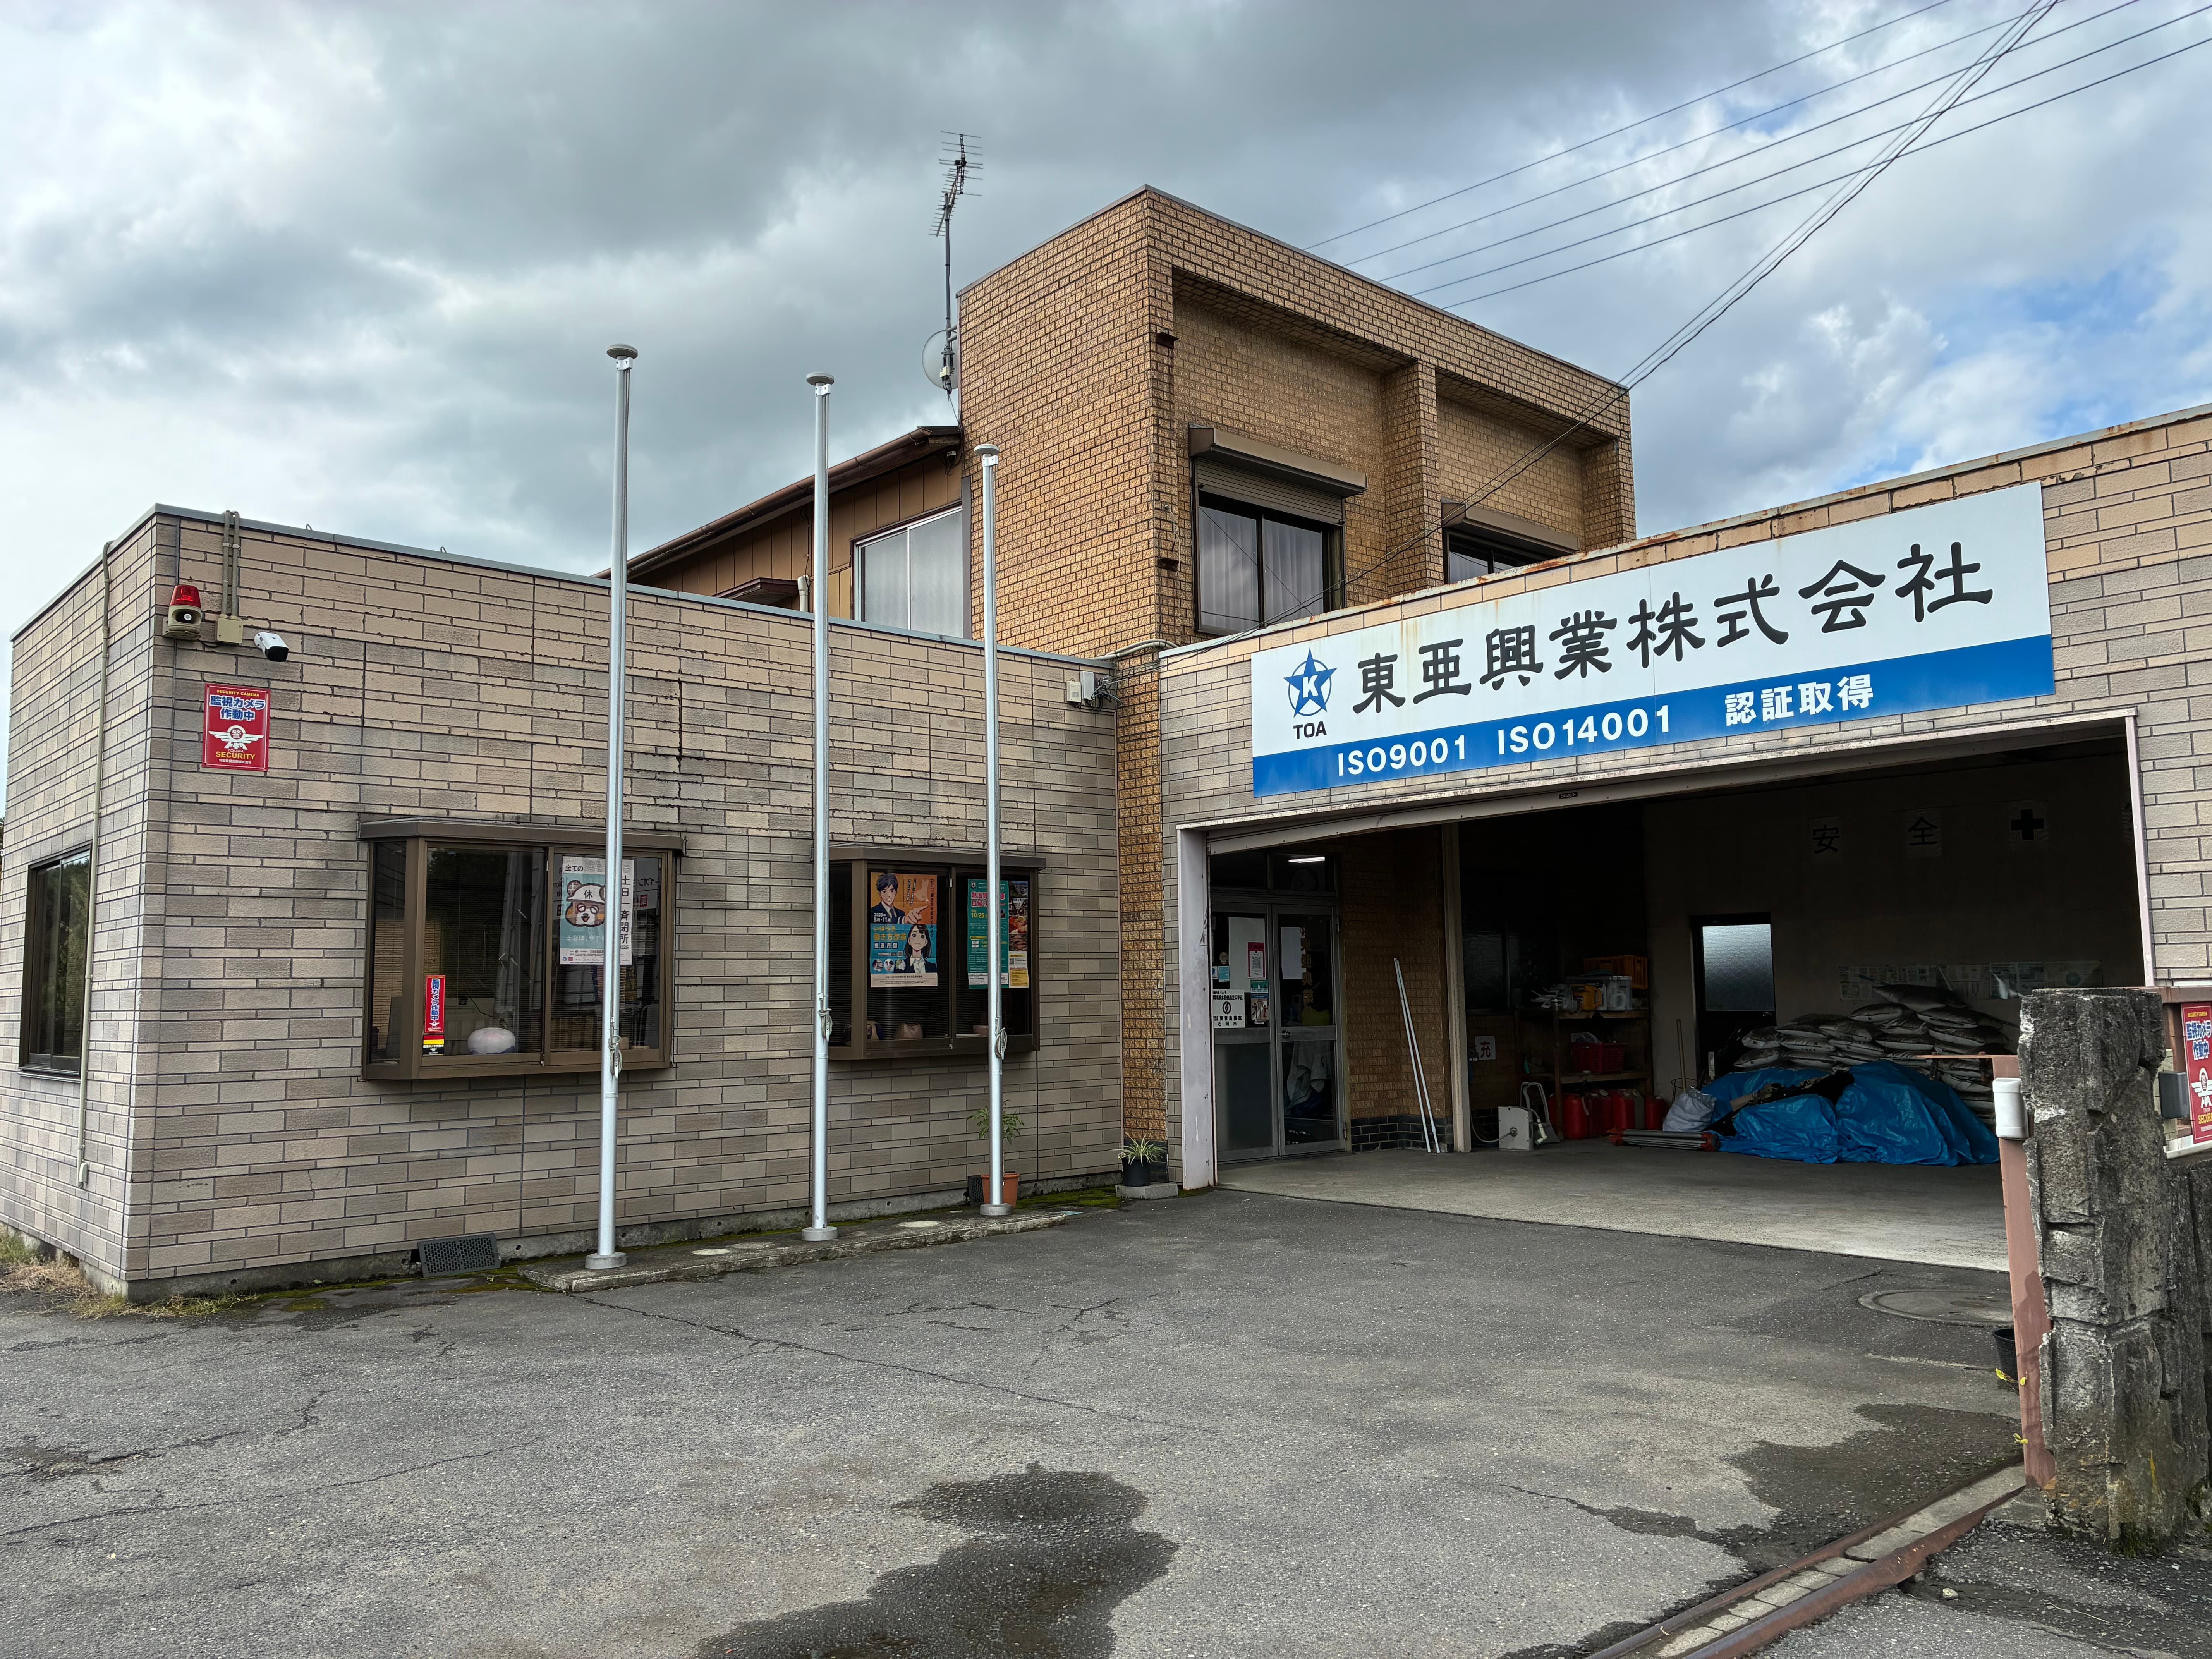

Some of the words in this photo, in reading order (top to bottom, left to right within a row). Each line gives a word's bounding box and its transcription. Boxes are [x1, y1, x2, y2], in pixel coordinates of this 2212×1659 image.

[1352, 541, 1993, 714] 東亜興業株式会社
[1303, 675, 1319, 698] K
[210, 695, 265, 710] 監視カメラ
[220, 708, 255, 721] 作動中
[1293, 721, 1327, 739] TOA
[1338, 735, 1465, 776] ISO9001
[1498, 705, 1669, 755] ISO14001
[1725, 674, 1874, 726] 認証取得
[216, 751, 255, 759] SECURITY
[1812, 825, 1840, 854] 安
[1908, 816, 1937, 846] 全
[584, 890, 593, 899] 休
[620, 875, 631, 944] 土日一斉閉所
[2186, 1020, 2211, 1040] 監視カメラ
[2193, 1039, 2209, 1060] 作動中
